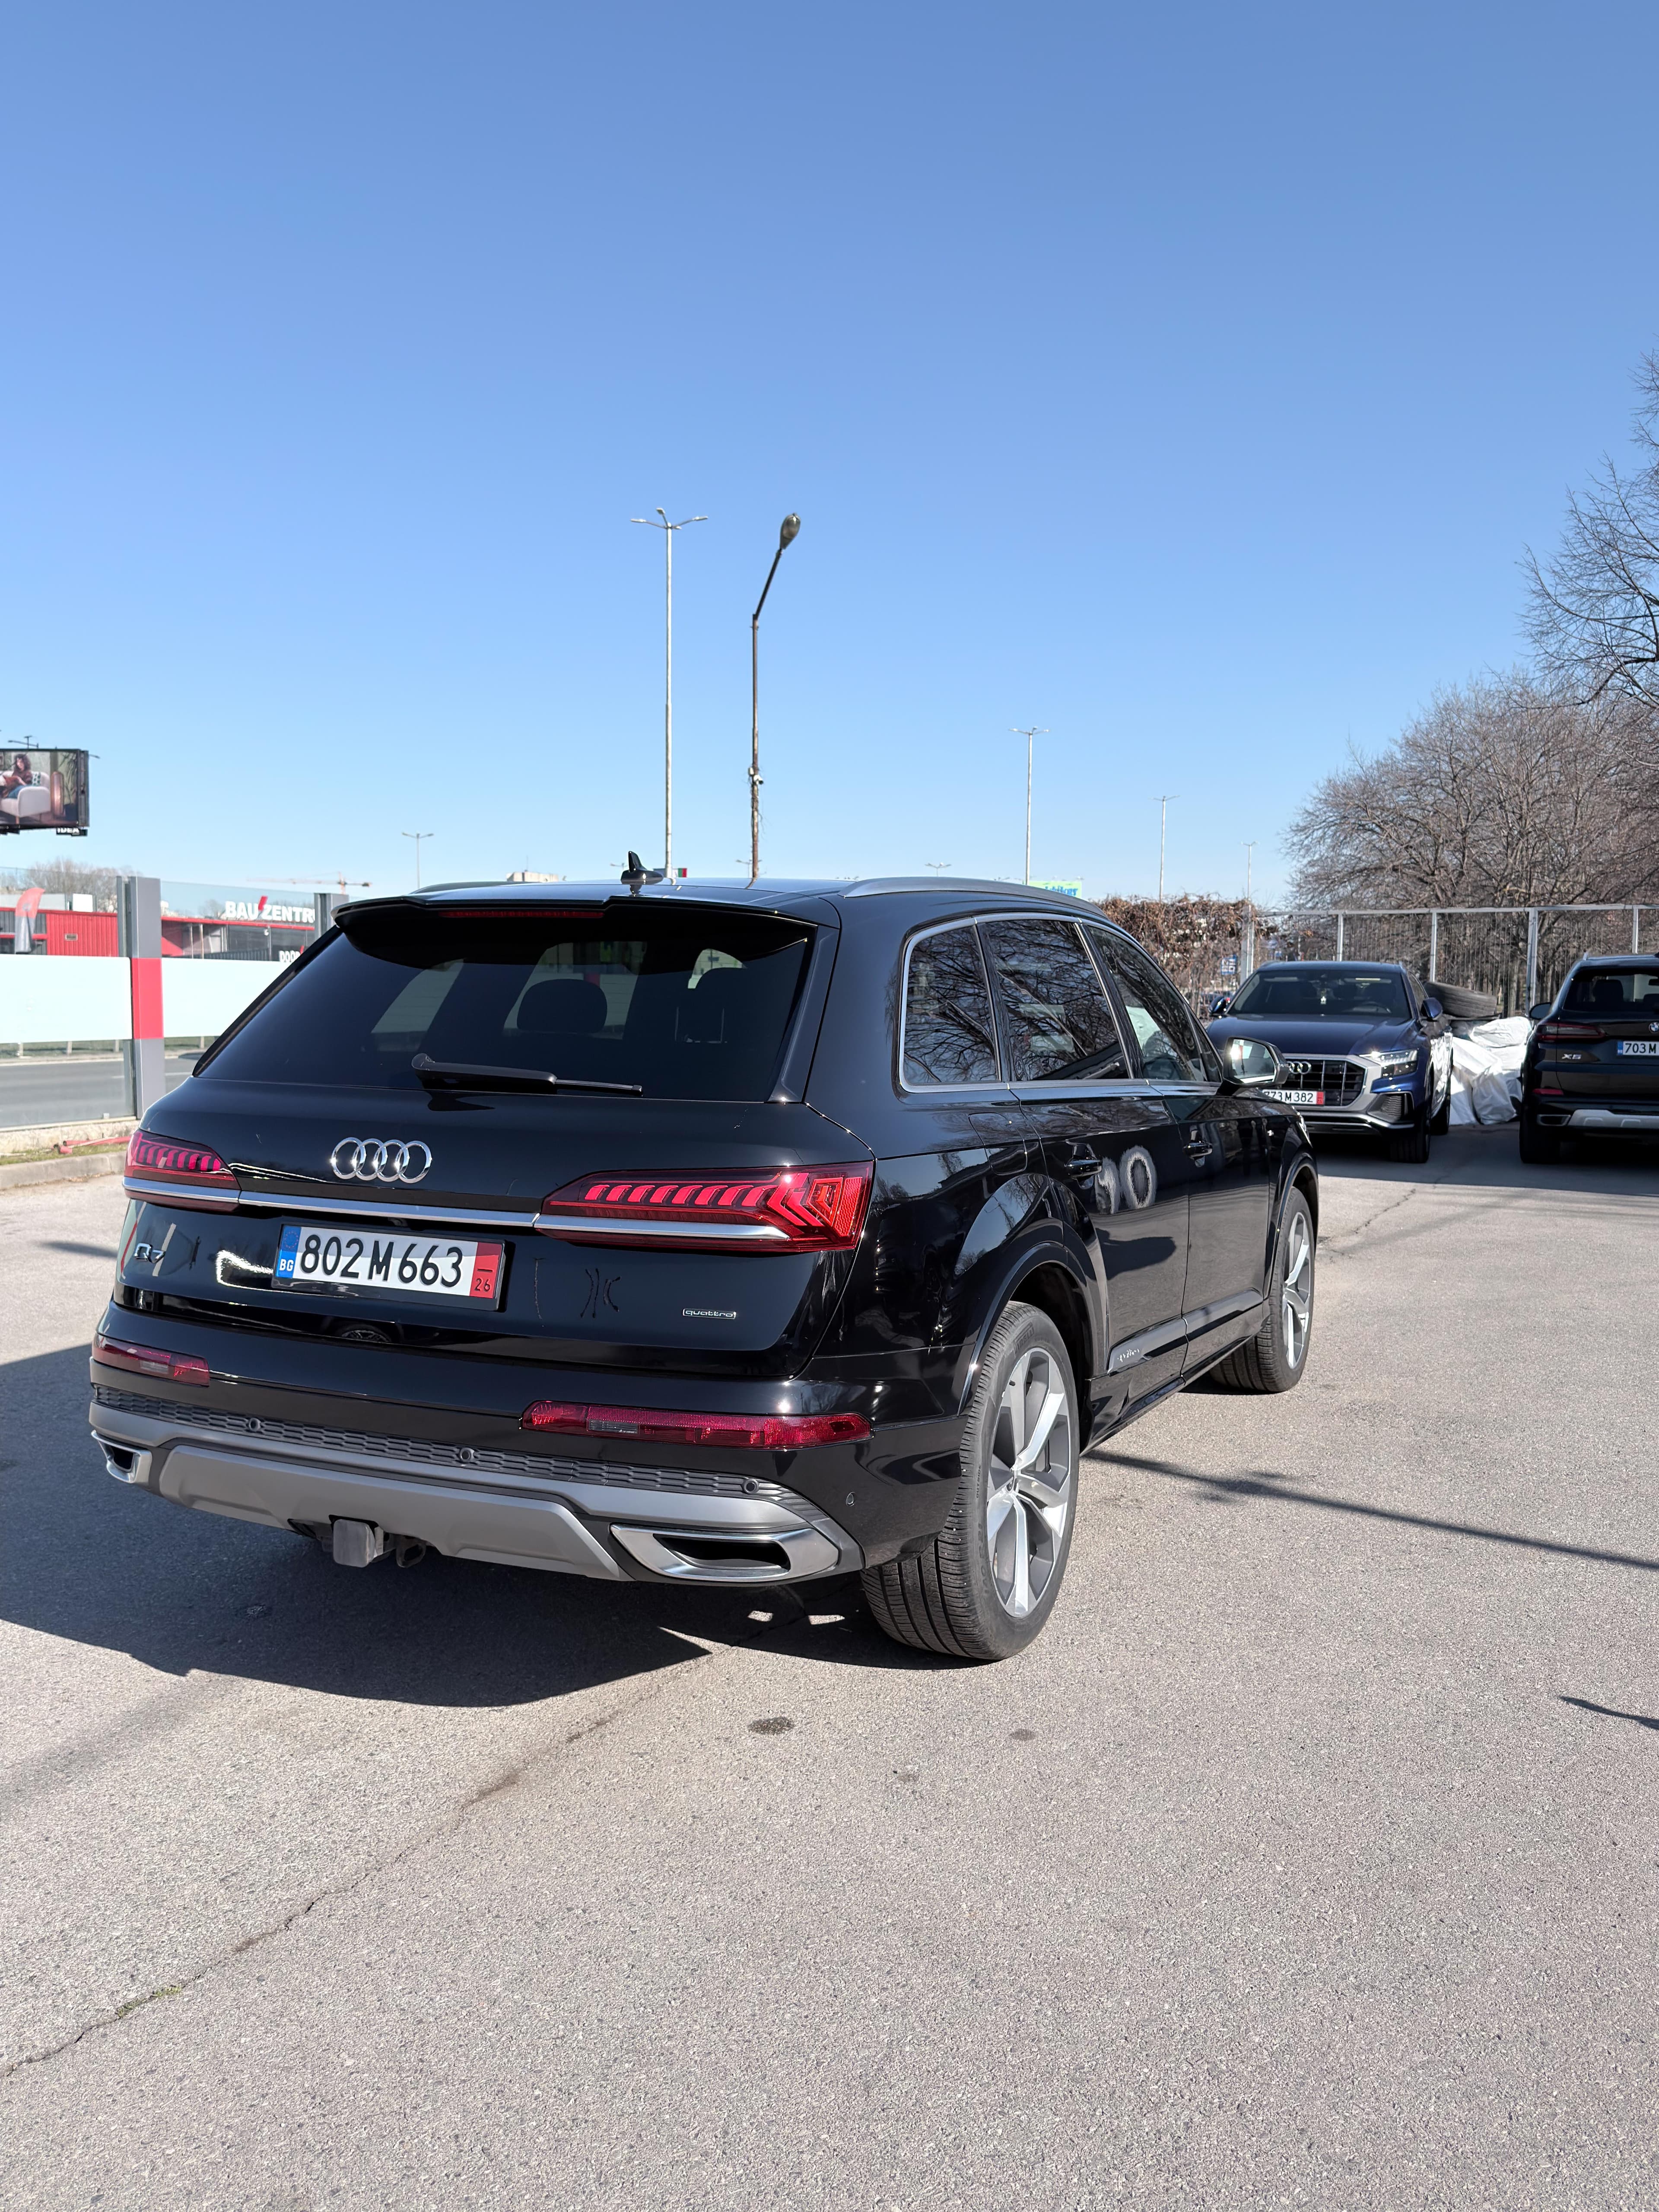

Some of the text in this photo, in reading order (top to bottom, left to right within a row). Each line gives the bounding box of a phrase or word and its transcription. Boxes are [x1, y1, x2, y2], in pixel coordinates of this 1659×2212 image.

[134, 1243, 166, 1263] Q7
[280, 1259, 294, 1271] BG
[474, 1278, 491, 1292] 26
